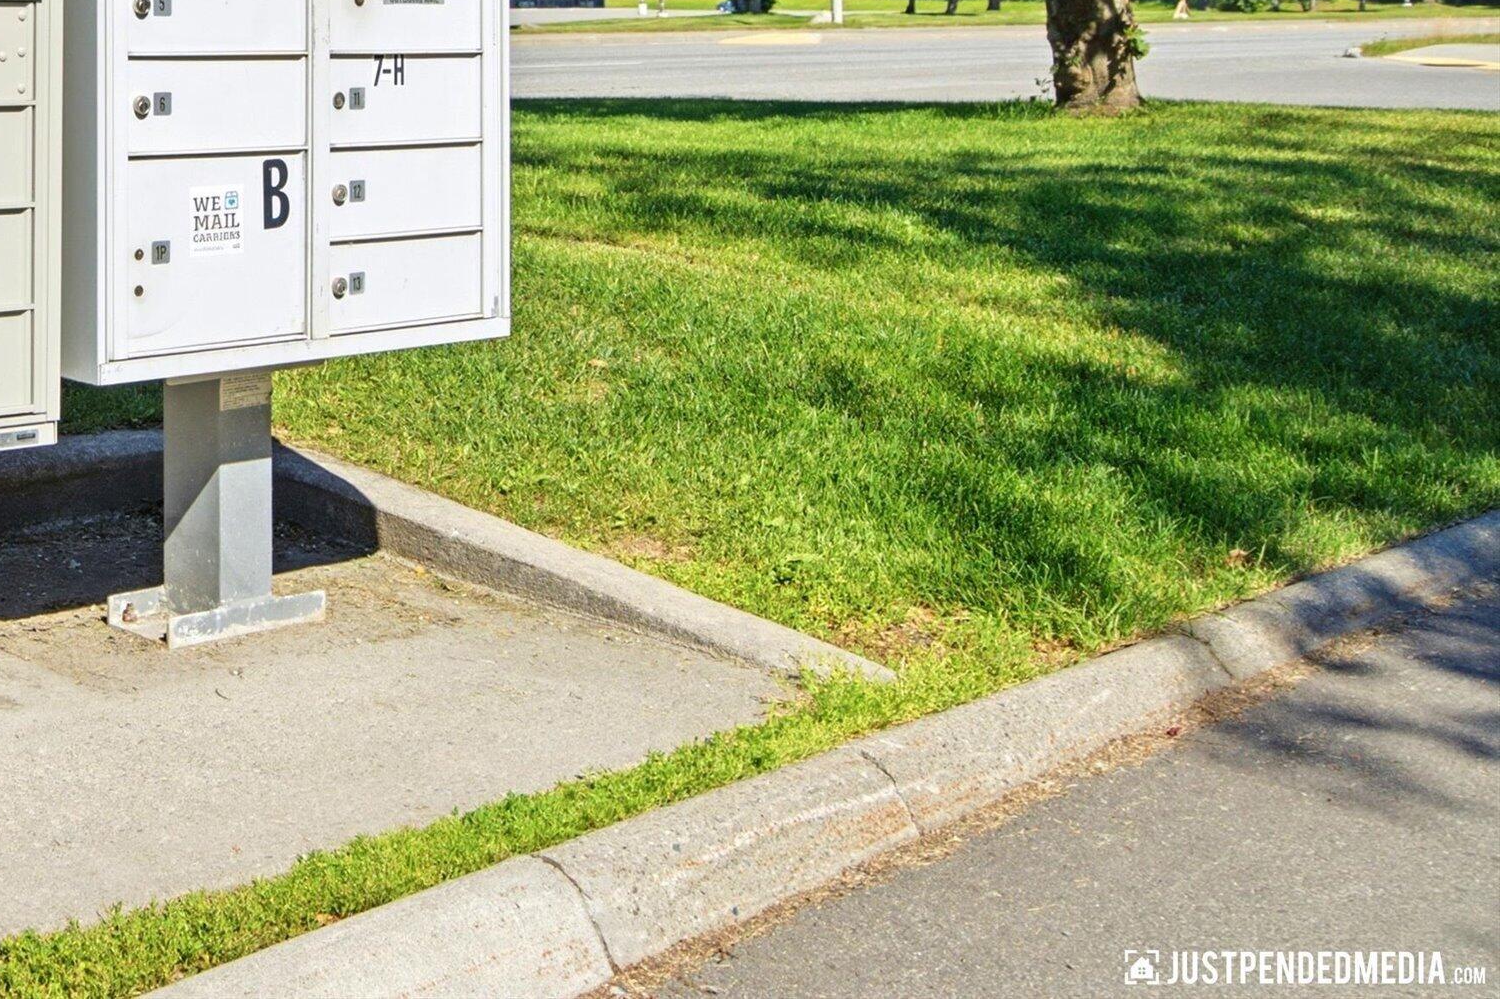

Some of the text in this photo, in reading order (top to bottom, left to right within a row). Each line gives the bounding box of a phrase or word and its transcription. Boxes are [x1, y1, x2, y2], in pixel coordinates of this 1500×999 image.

[159, 97, 166, 111] 6
[353, 92, 361, 105] 11
[263, 159, 289, 229] B
[353, 185, 362, 198] 12
[193, 196, 221, 212] WE
[193, 213, 240, 231] MAIL
[155, 245, 167, 260] 1P
[352, 277, 361, 290] 13
